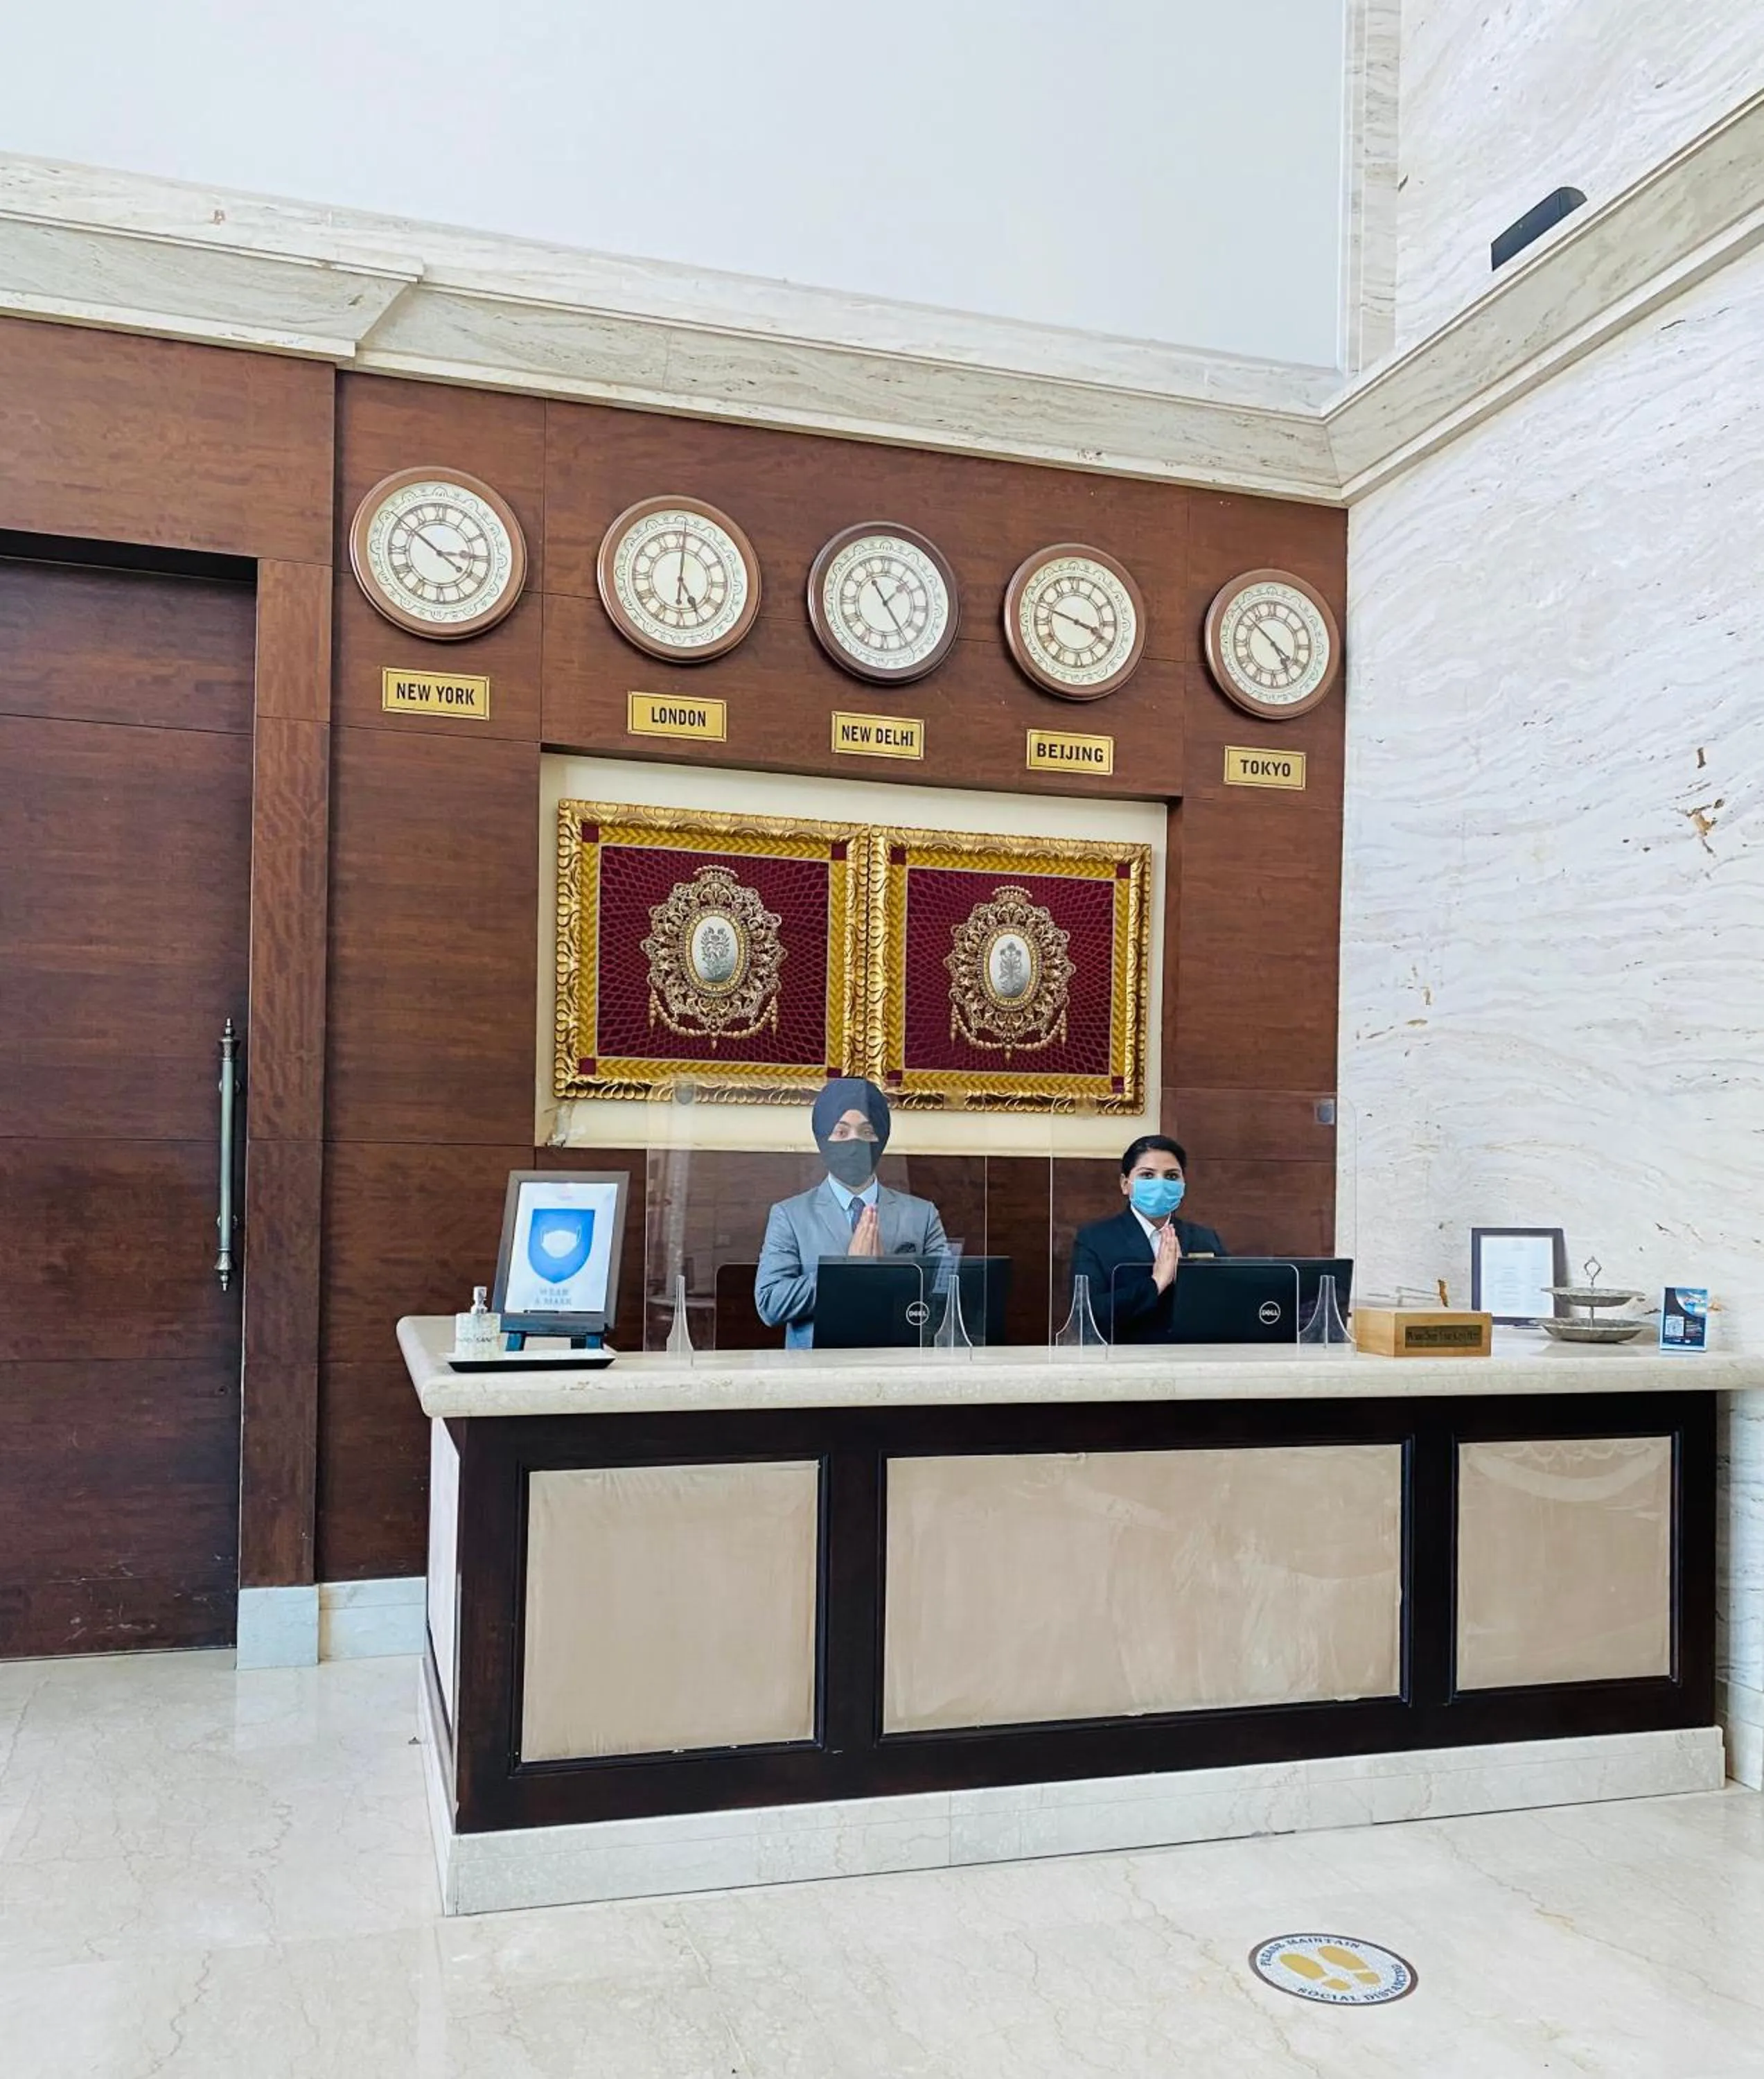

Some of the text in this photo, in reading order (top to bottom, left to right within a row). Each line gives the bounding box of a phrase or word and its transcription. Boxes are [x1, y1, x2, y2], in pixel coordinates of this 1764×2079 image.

[396, 682, 475, 705] NEW YORK
[651, 706, 706, 727] LONDON
[842, 724, 914, 746] NEW DELHI
[1037, 742, 1104, 762] BEIJING
[1240, 759, 1291, 777] TOKYO
[538, 1287, 570, 1296] WEAR
[1260, 1938, 1360, 1966] PLEASE MAINTAIN
[1297, 1963, 1407, 2001] SOCIAL DISTANCING
